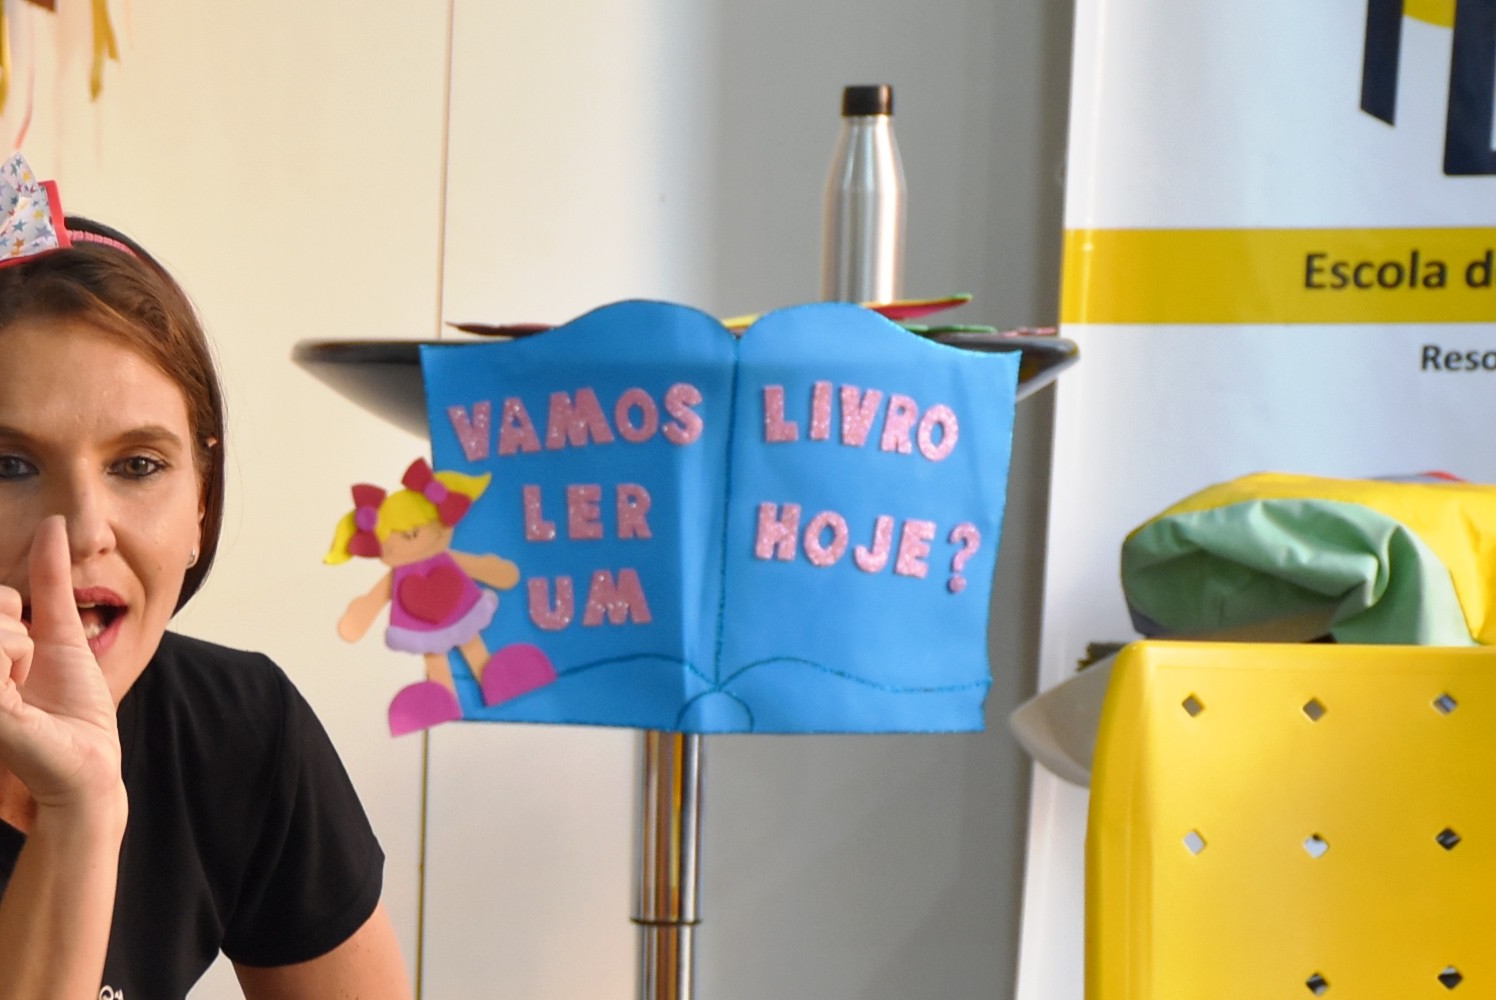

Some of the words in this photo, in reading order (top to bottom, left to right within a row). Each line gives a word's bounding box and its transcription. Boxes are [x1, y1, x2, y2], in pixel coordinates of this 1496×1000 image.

[1304, 249, 1449, 290] Escola
[447, 382, 704, 463] VAMOS
[762, 381, 960, 463] LIVRO
[522, 483, 652, 542] LER
[527, 568, 652, 631] UM
